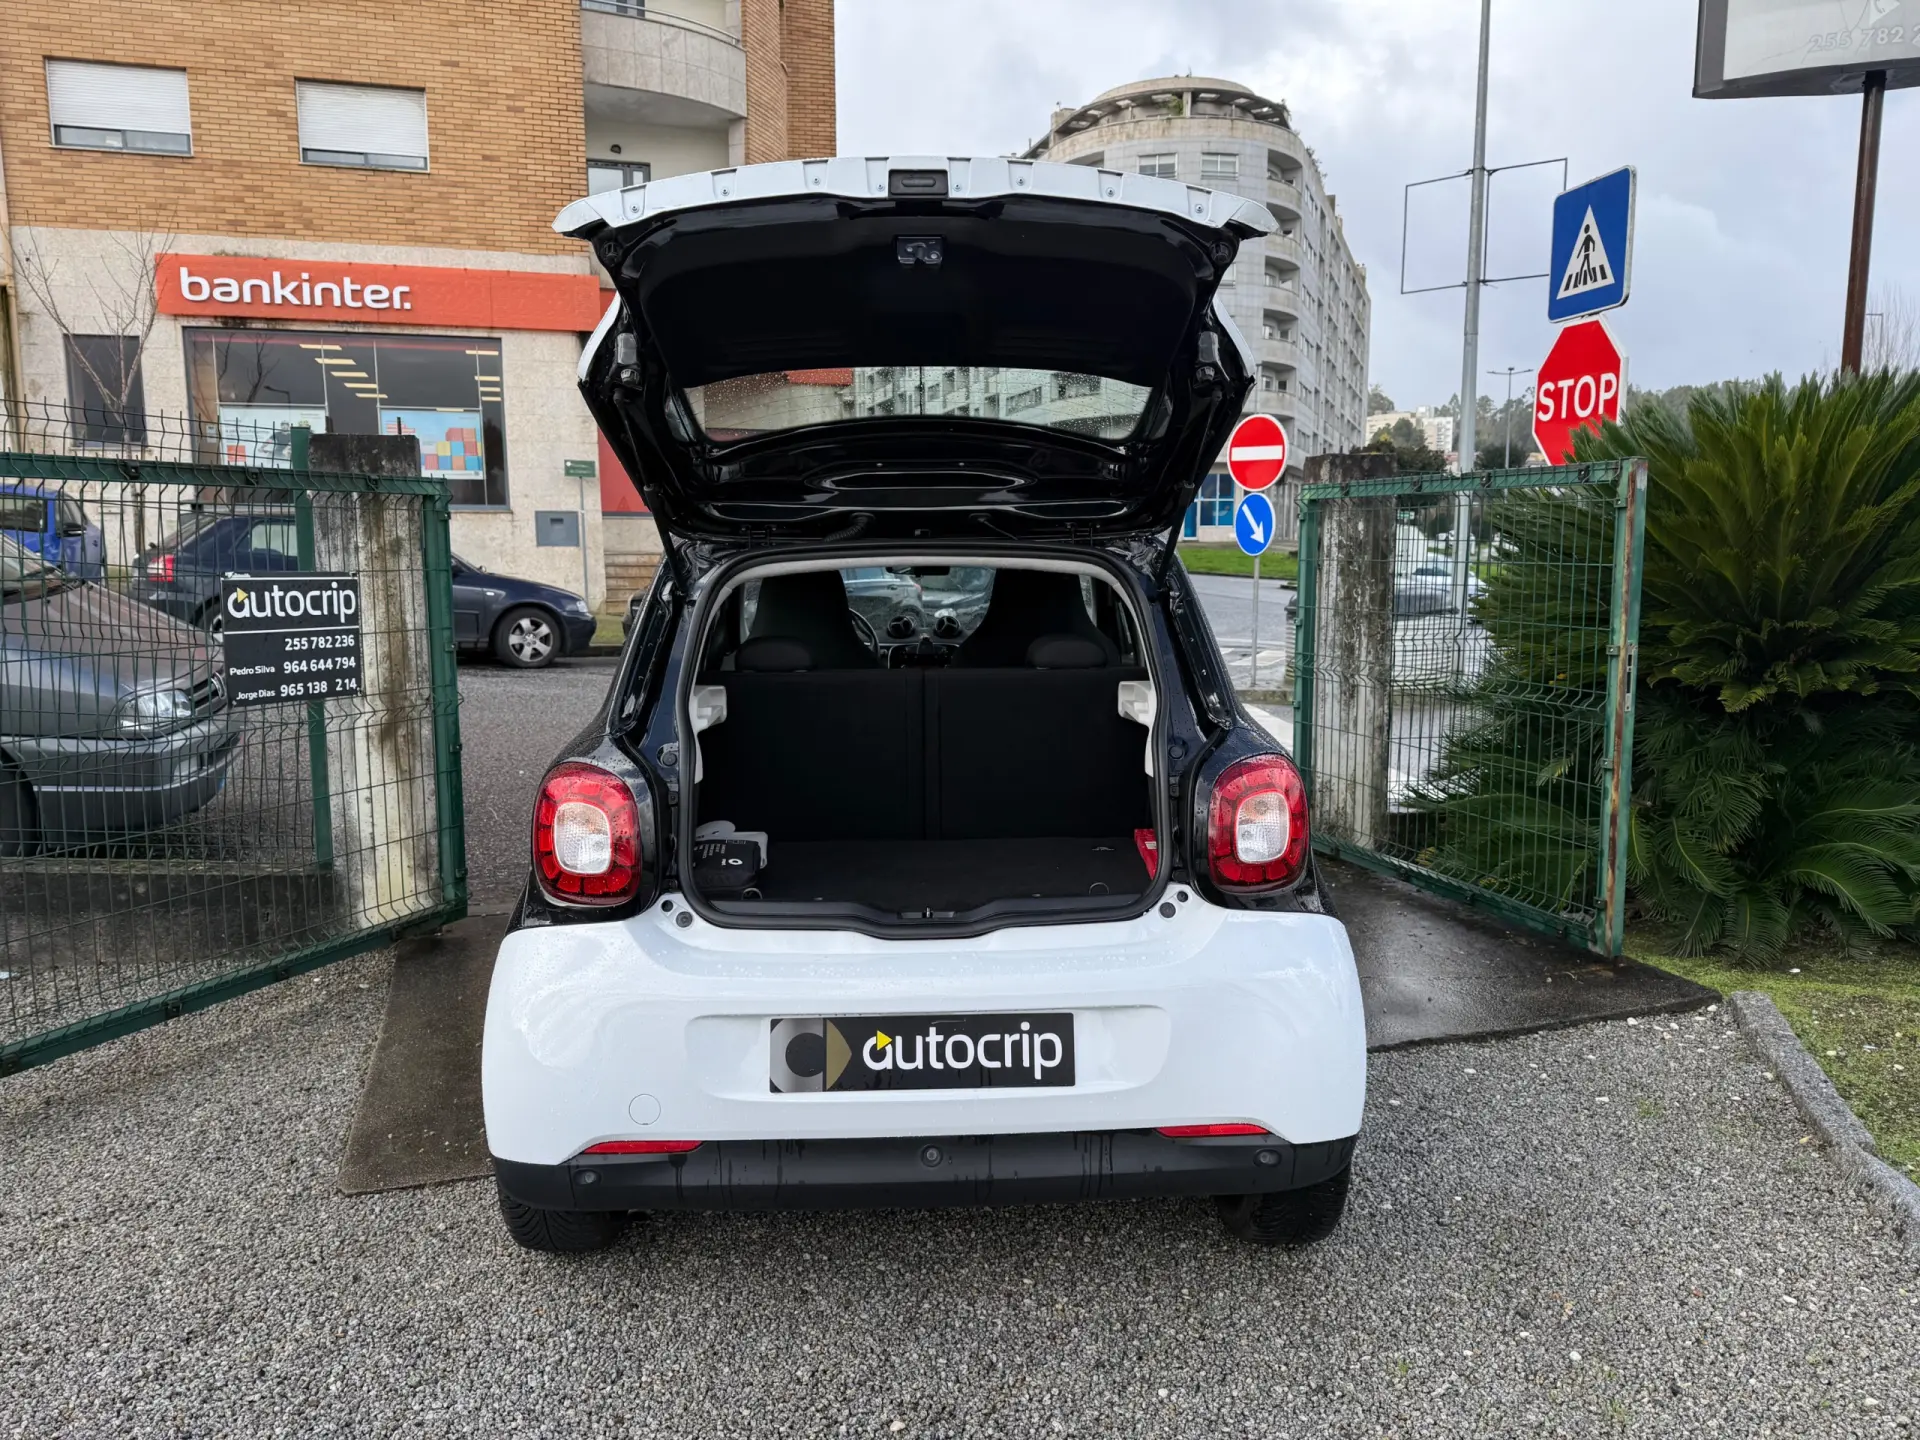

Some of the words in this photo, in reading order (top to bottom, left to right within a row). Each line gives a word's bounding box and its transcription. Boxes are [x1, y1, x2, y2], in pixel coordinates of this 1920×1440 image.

[1807, 30, 1852, 53] 255
[1861, 26, 1904, 48] 782
[1537, 372, 1618, 422] STOP
[227, 581, 356, 623] autocrip
[284, 637, 308, 651] 255
[310, 636, 333, 649] 782
[334, 634, 355, 648] 236
[229, 667, 254, 676] Pedro
[255, 665, 276, 673] Silva
[283, 661, 308, 674] 964
[309, 659, 333, 672] 644
[335, 656, 356, 670] 794
[236, 691, 258, 700] Jorge
[258, 689, 276, 698] Dias
[280, 683, 304, 697] 965
[307, 681, 328, 694] 138
[335, 678, 357, 691] 214
[862, 1021, 1063, 1080] autocrip
